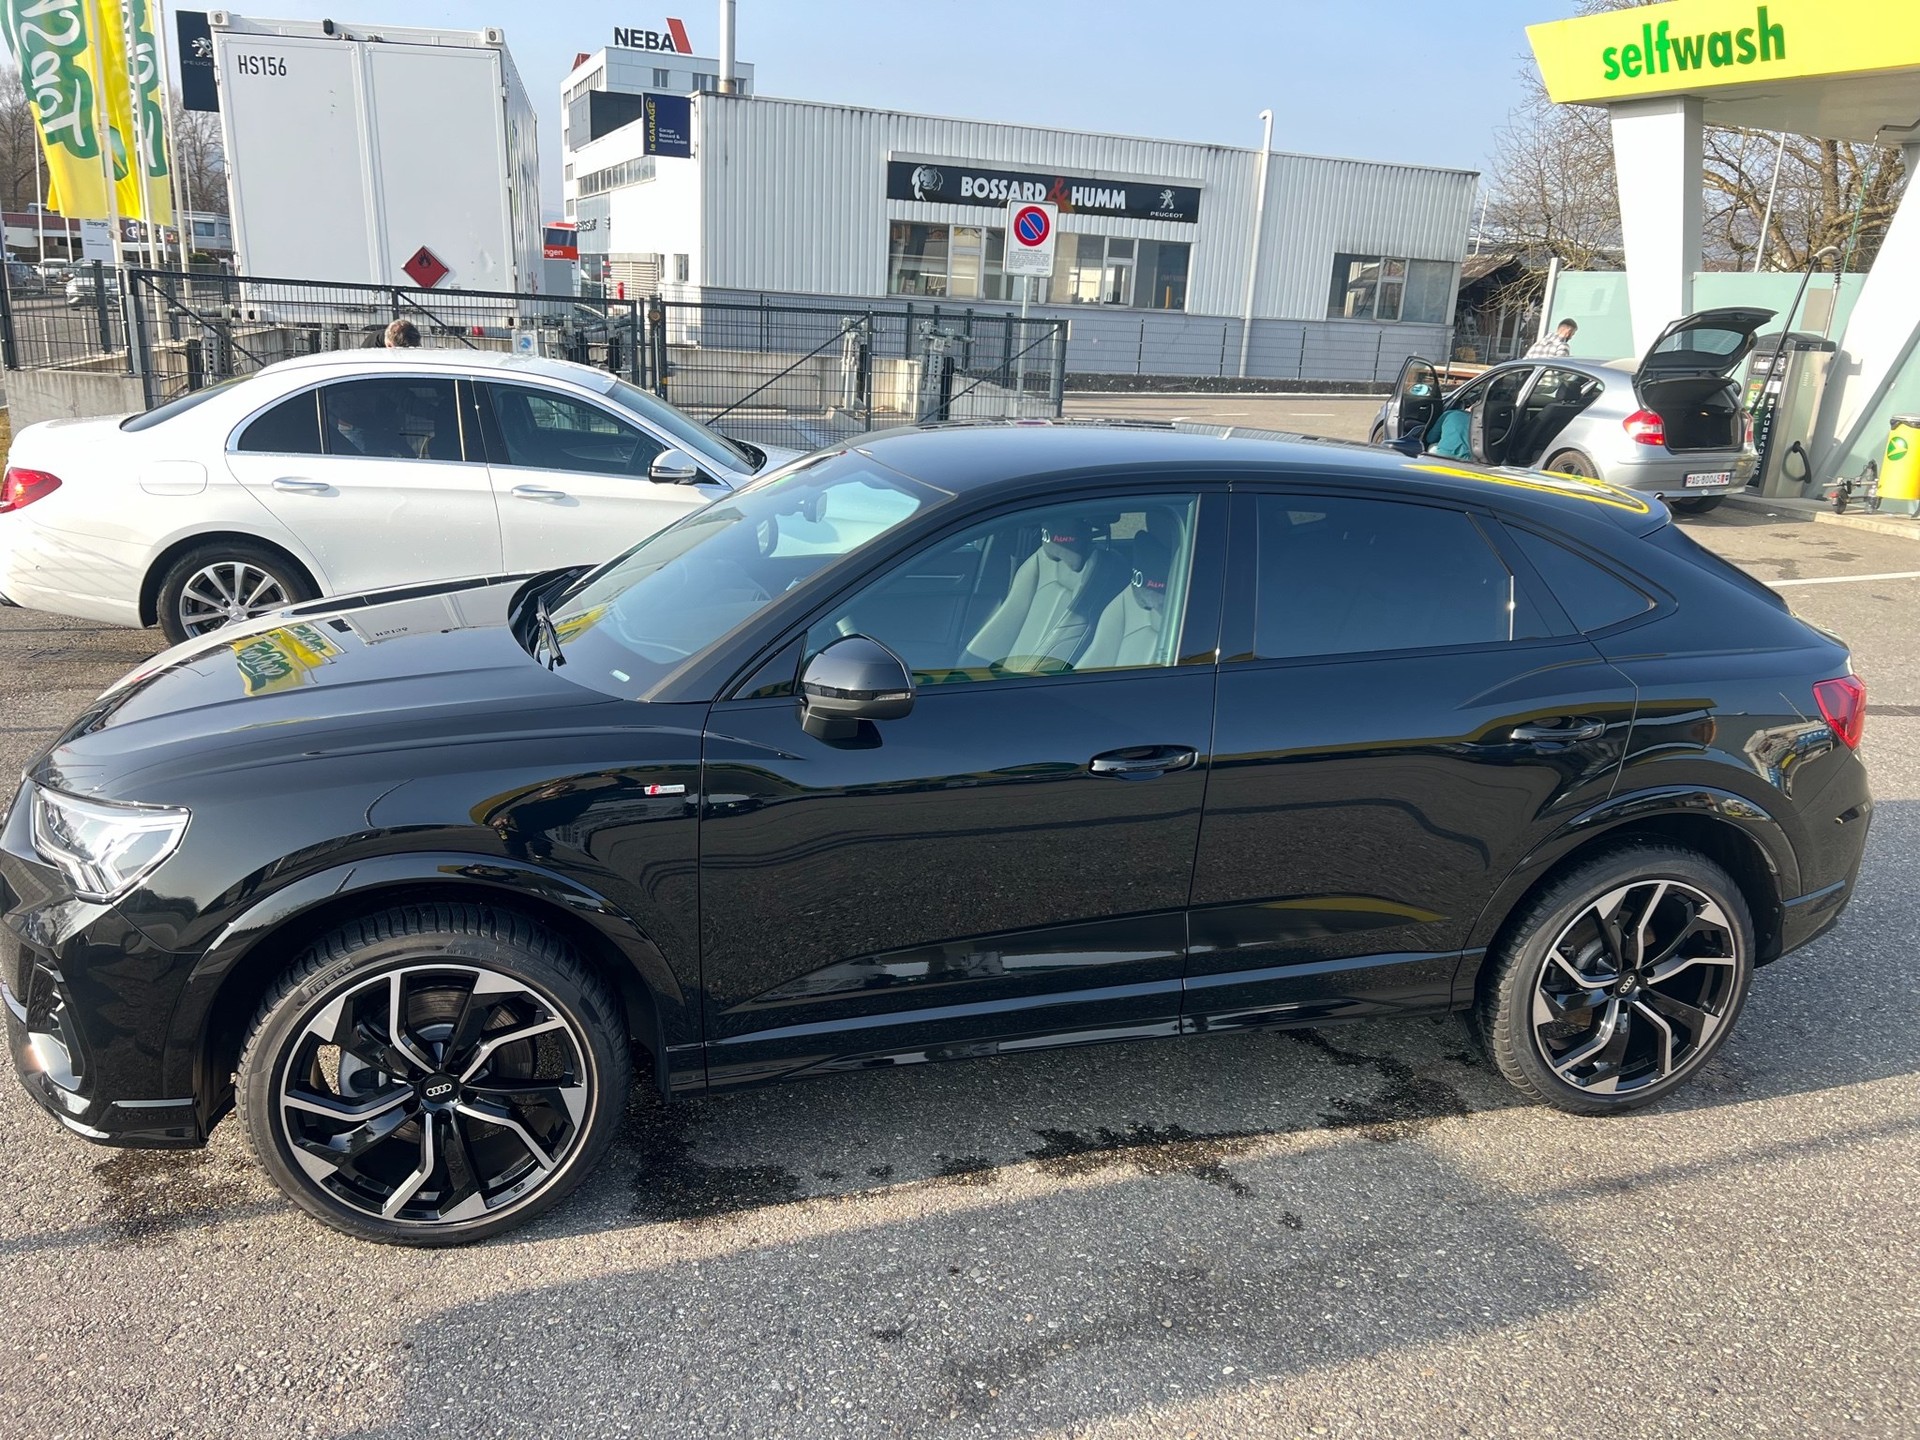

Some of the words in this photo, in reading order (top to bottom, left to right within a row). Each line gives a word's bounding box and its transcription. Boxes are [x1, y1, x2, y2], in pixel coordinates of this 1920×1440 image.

[614, 27, 676, 53] NEBA
[1602, 6, 1786, 81] selfwash
[237, 55, 287, 76] HS156
[648, 102, 656, 142] GARAGE
[960, 176, 1047, 201] BOSSARD
[1071, 186, 1126, 210] HUMM
[1150, 211, 1184, 219] PEUGEOT
[300, 957, 355, 999] PIRELLI
